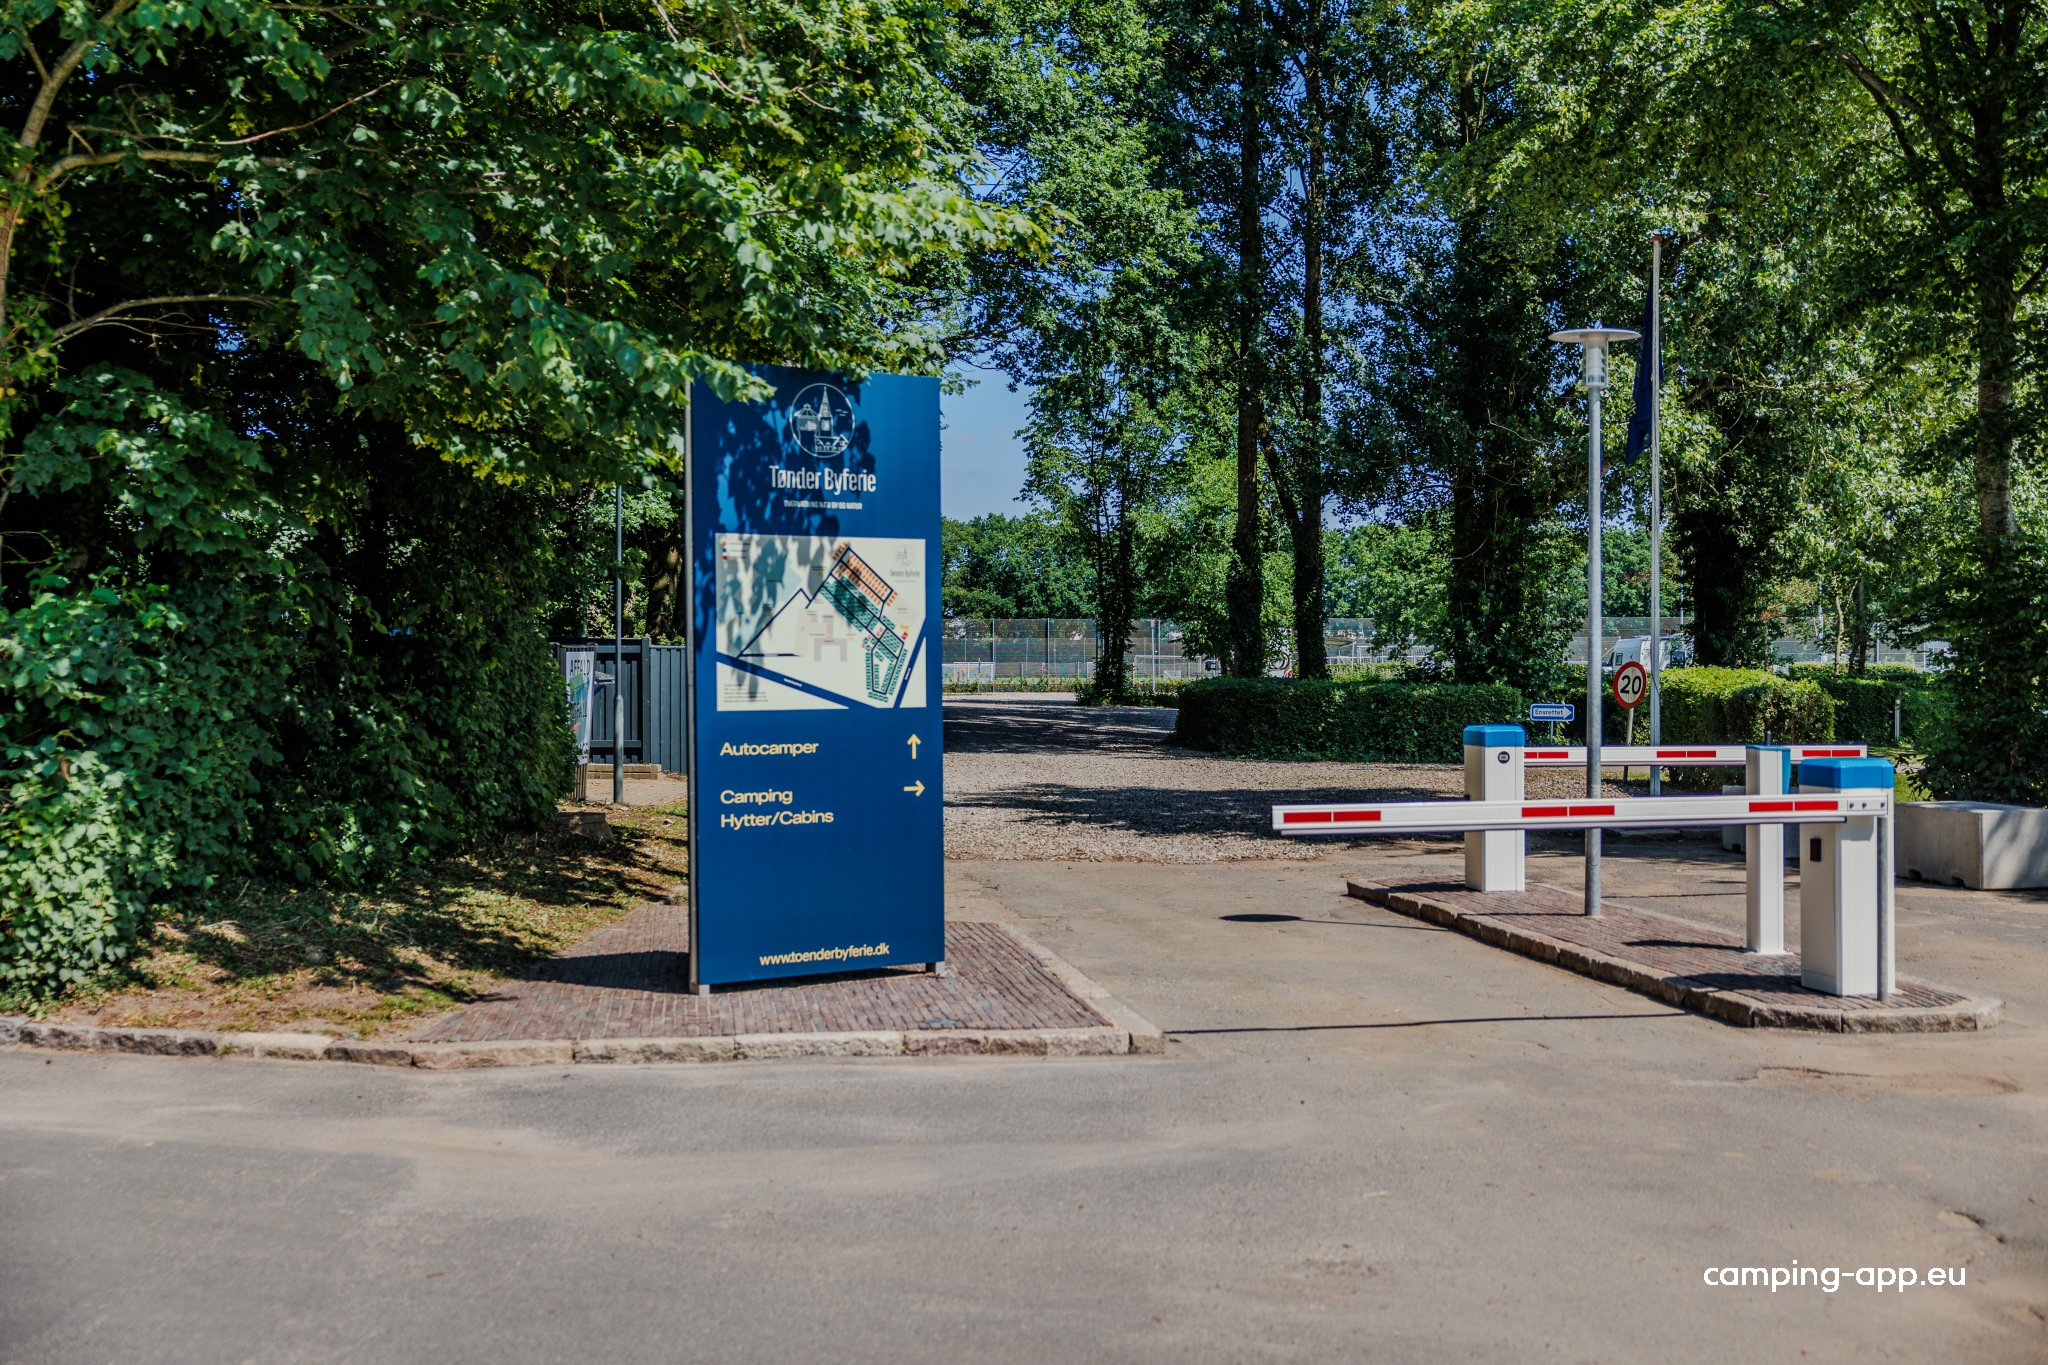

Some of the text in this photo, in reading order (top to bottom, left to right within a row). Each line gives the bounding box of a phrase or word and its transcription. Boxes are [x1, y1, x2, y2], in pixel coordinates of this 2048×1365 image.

[769, 465, 877, 496] Tønder Byferie
[1620, 674, 1642, 695] 20
[720, 742, 819, 757] Autocamper
[720, 788, 793, 805] Camping
[720, 810, 834, 830] Hytter/Cabins
[759, 942, 890, 966] www.toenderbyferie.dk
